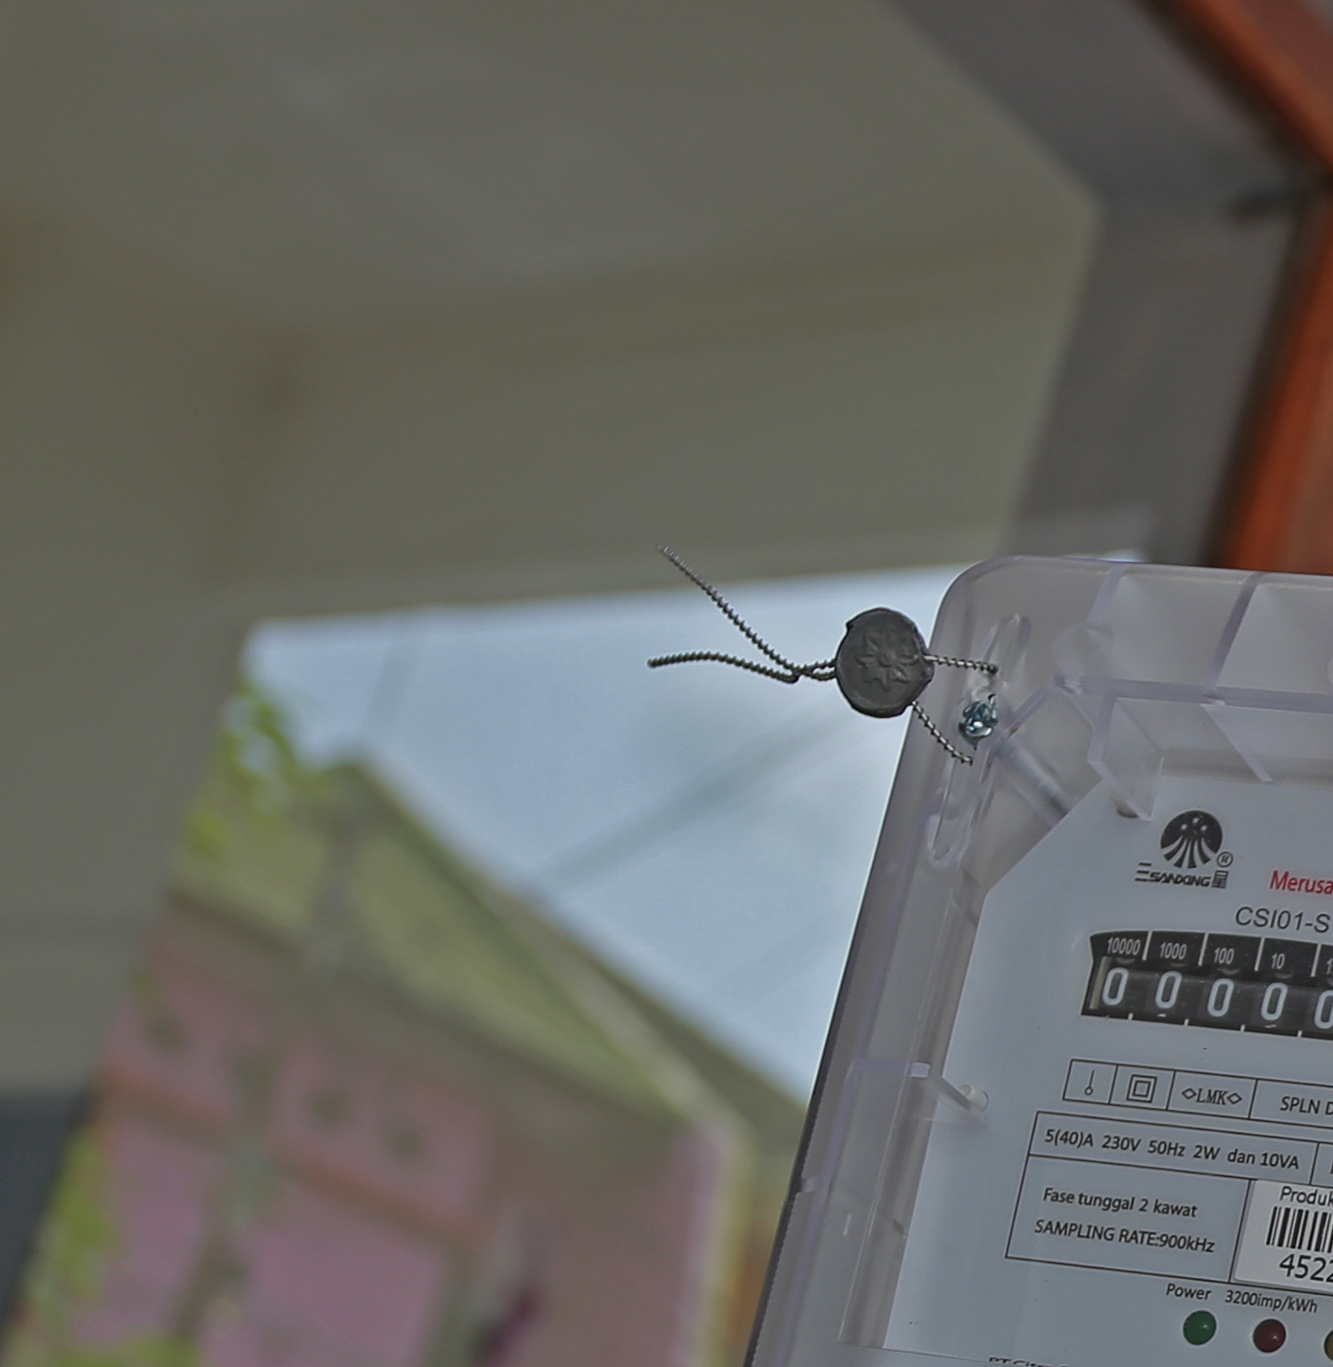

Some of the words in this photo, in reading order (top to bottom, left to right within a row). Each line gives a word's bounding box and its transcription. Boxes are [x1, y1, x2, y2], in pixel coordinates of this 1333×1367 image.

[1106, 937, 1141, 955] 10000
[1159, 942, 1187, 960] 1000
[1213, 947, 1235, 965] 100
[1270, 953, 1286, 969] 10
[1326, 958, 1333, 974] 1
[1196, 1088, 1228, 1105] LMK
[1280, 1095, 1321, 1115] SPLN
[1044, 1129, 1094, 1148] 5(40)A
[1101, 1134, 1142, 1151] 230V
[1147, 1140, 1186, 1157] 50Hz
[1193, 1144, 1220, 1160] 2W
[1227, 1149, 1255, 1165] dan
[1259, 1152, 1299, 1170] 10VA
[1043, 1187, 1075, 1205] Fase
[1078, 1192, 1134, 1212] tunggal
[1138, 1198, 1149, 1212] 2
[1153, 1200, 1197, 1218] kawat
[1034, 1219, 1115, 1242] SAMPLING
[1165, 1283, 1212, 1301] Power
[1224, 1290, 1318, 1314] 3200imp/kWh
